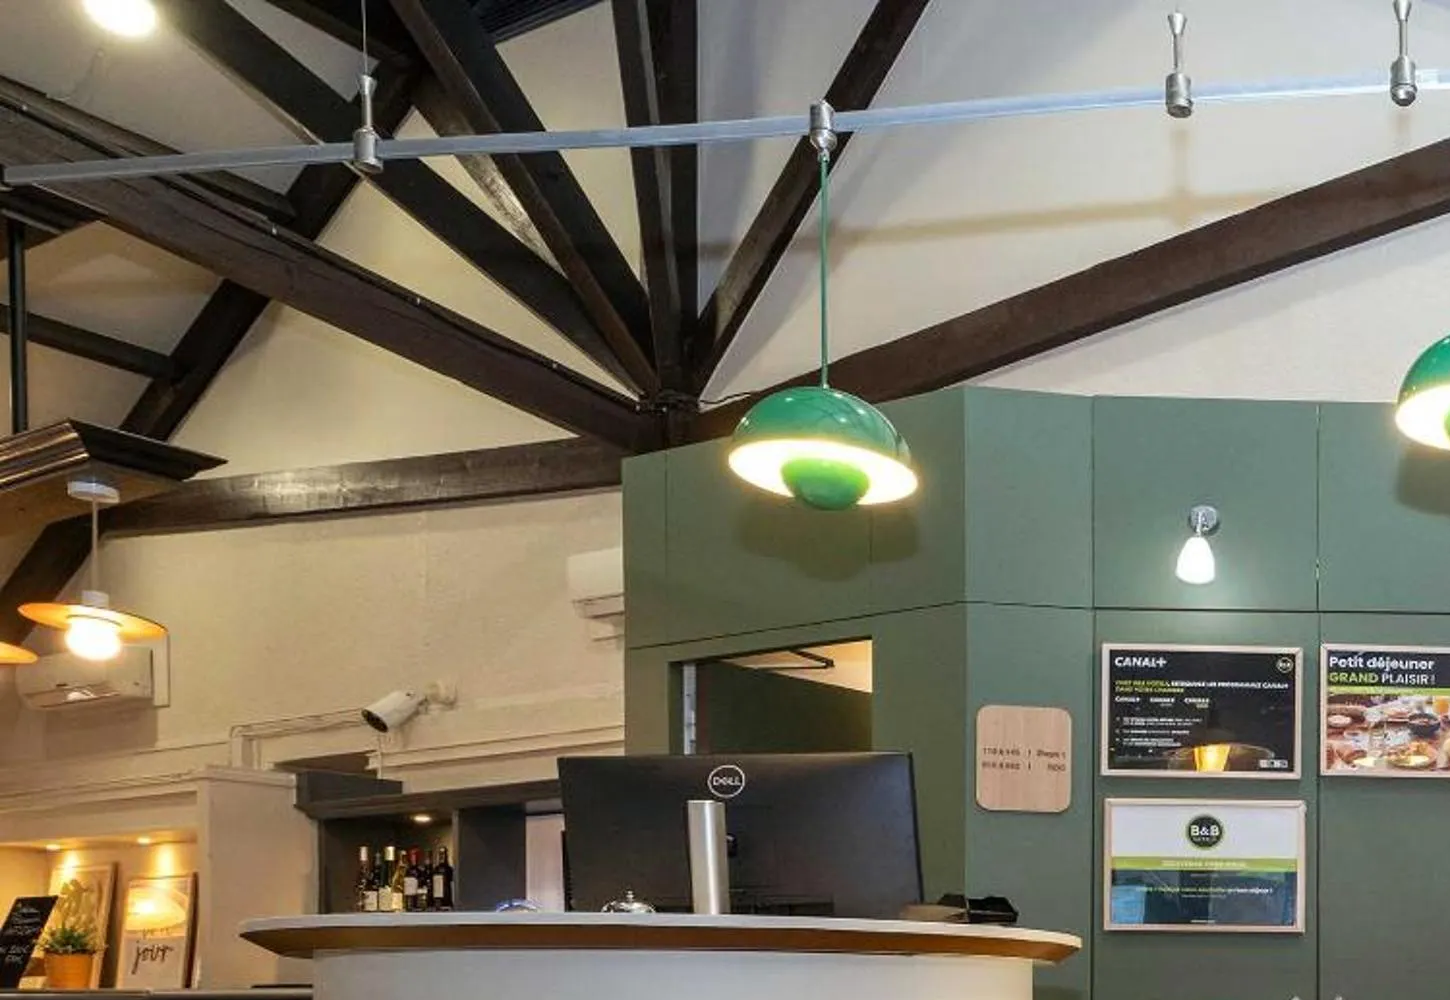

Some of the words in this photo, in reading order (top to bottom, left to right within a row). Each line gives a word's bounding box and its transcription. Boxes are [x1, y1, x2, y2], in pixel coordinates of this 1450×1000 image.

[1114, 656, 1167, 668] CANAL+
[1329, 655, 1364, 668] Petit
[1366, 656, 1435, 672] déjeuner
[1329, 671, 1379, 683] GRAND
[1381, 673, 1429, 685] PLAISIR
[713, 776, 741, 786] DELL
[1190, 824, 1220, 836] B&B
